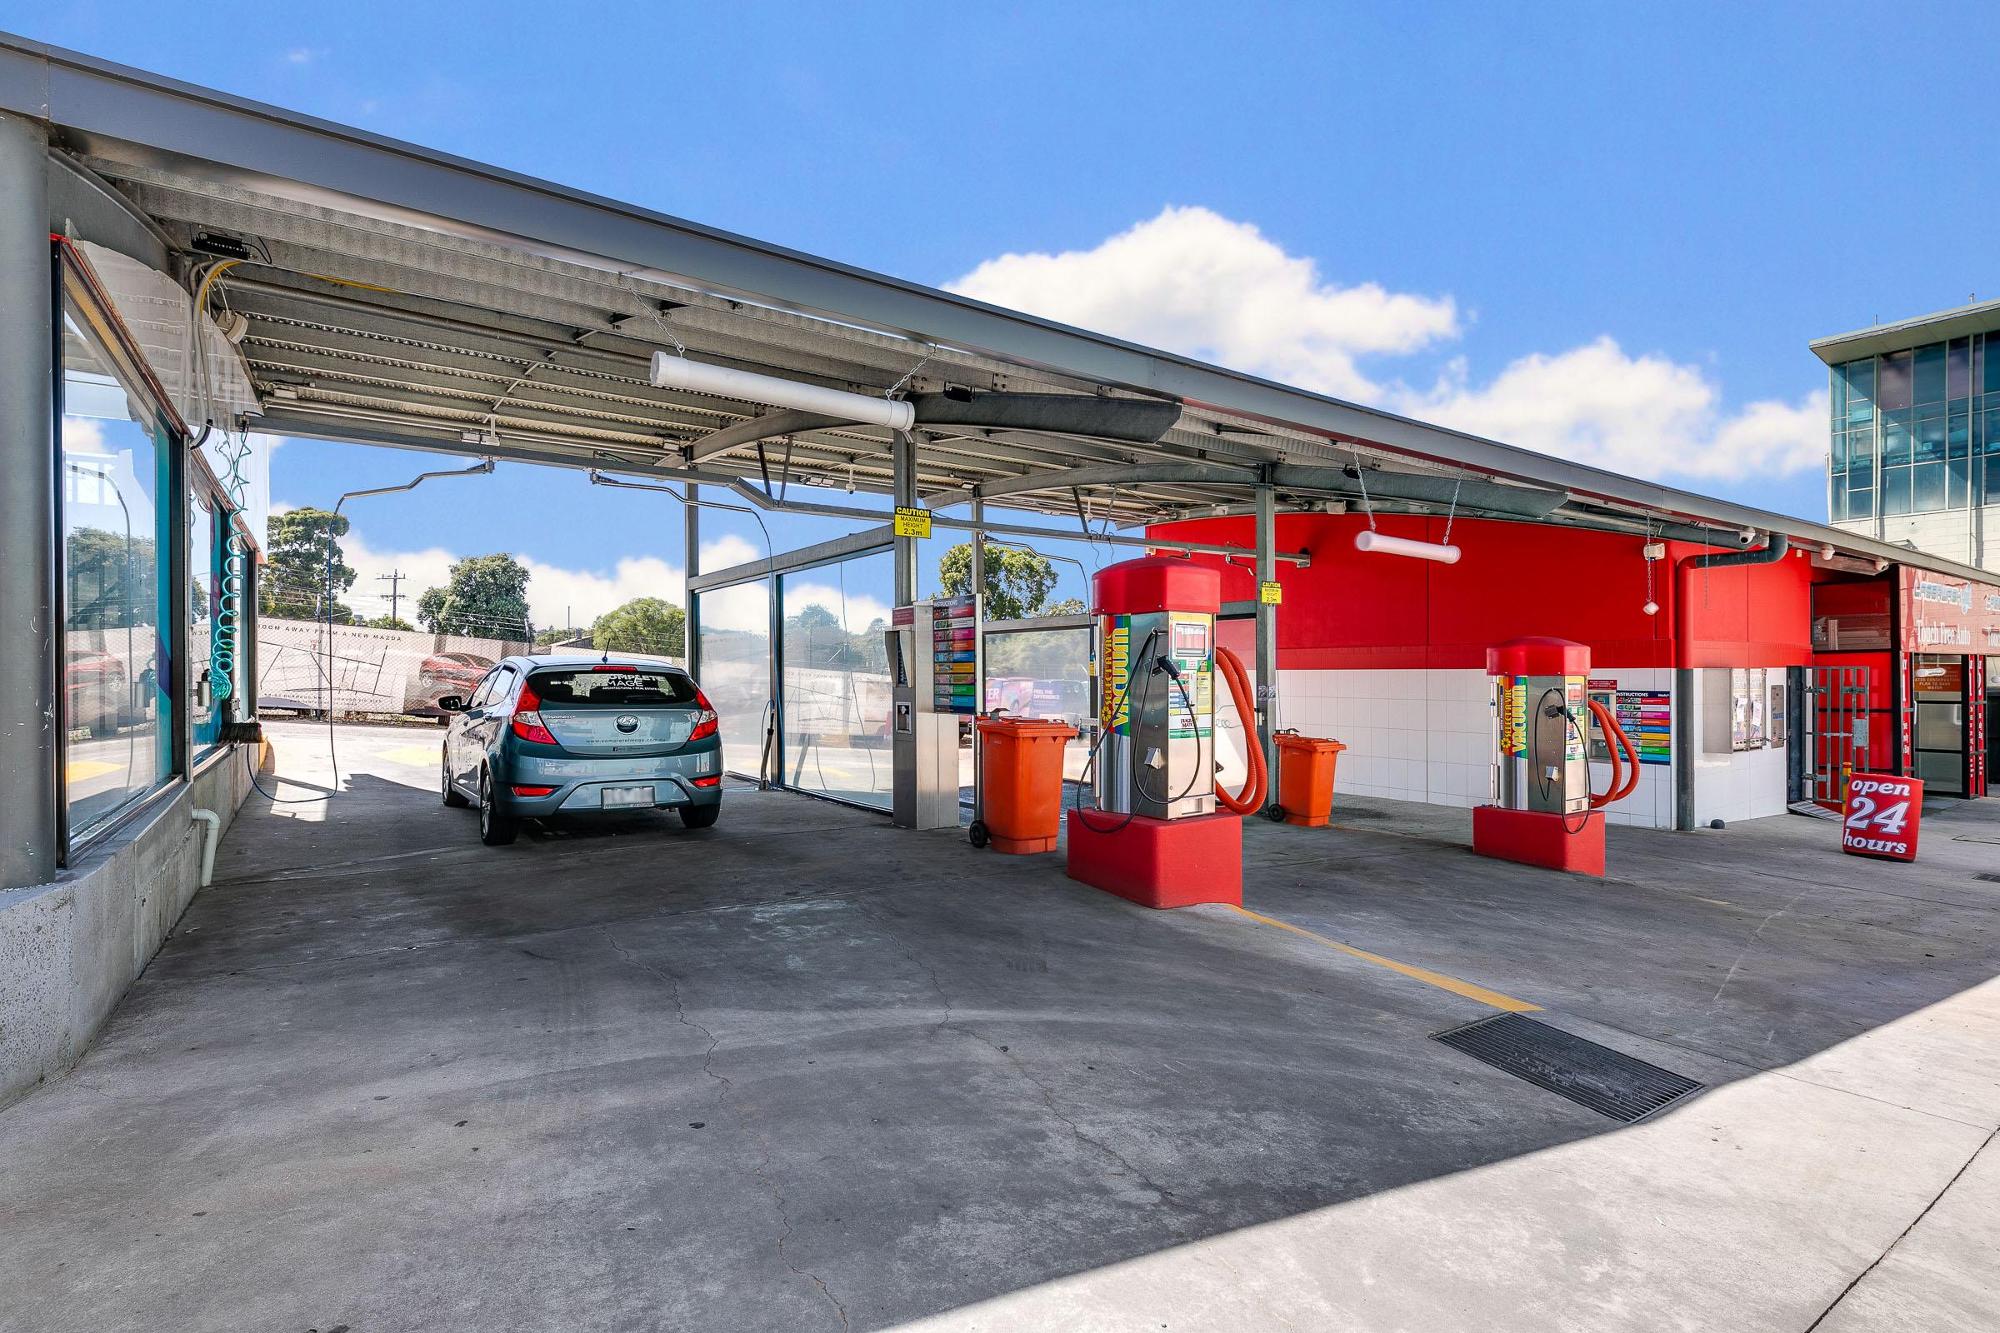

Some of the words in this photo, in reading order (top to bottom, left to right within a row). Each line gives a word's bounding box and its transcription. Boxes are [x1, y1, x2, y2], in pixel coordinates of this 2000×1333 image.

[896, 506, 930, 518] CAUTION
[1112, 627, 1129, 728] VACUUM
[1512, 684, 1526, 752] VACUUM
[1851, 780, 1910, 796] open
[1846, 796, 1910, 834] 24
[1844, 828, 1907, 854] hours
